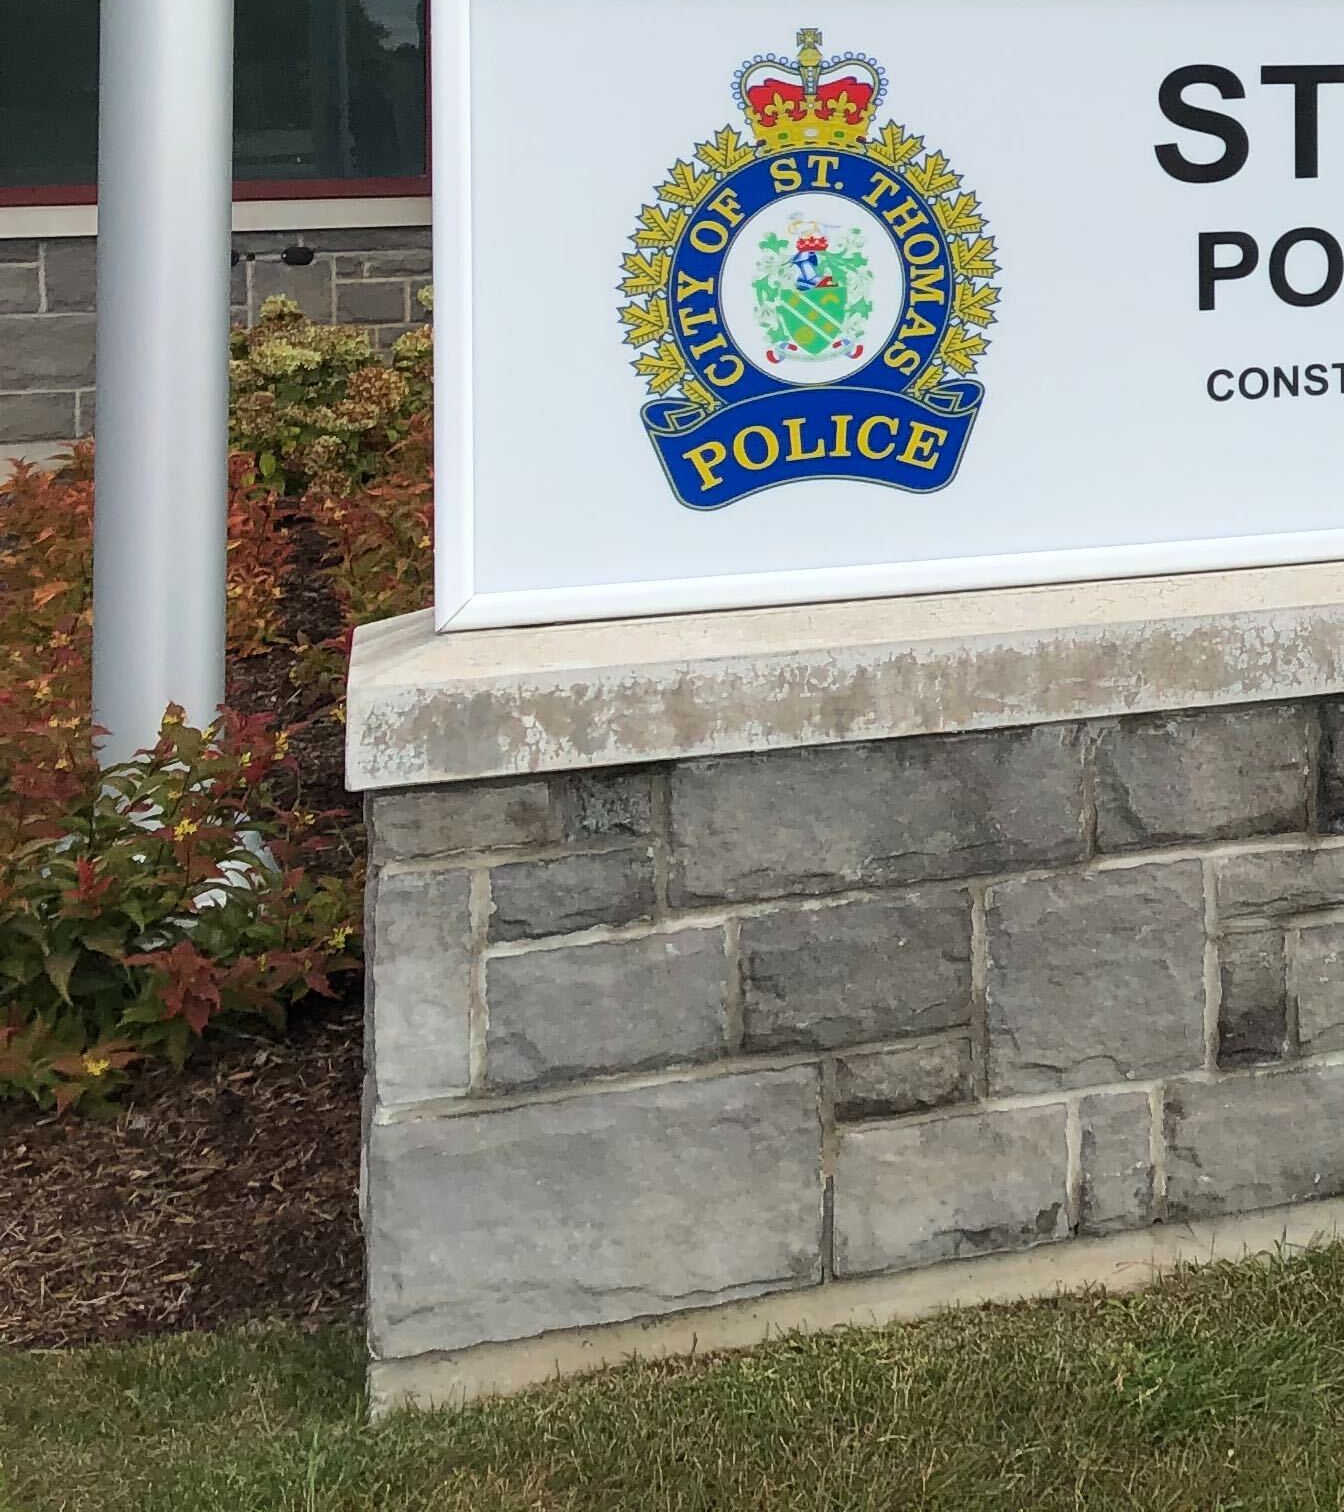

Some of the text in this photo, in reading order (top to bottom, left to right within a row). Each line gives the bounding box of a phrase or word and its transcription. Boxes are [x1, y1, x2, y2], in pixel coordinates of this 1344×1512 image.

[677, 153, 945, 387] CITY OF ST. THOMAS
[681, 414, 949, 492] POLICE
